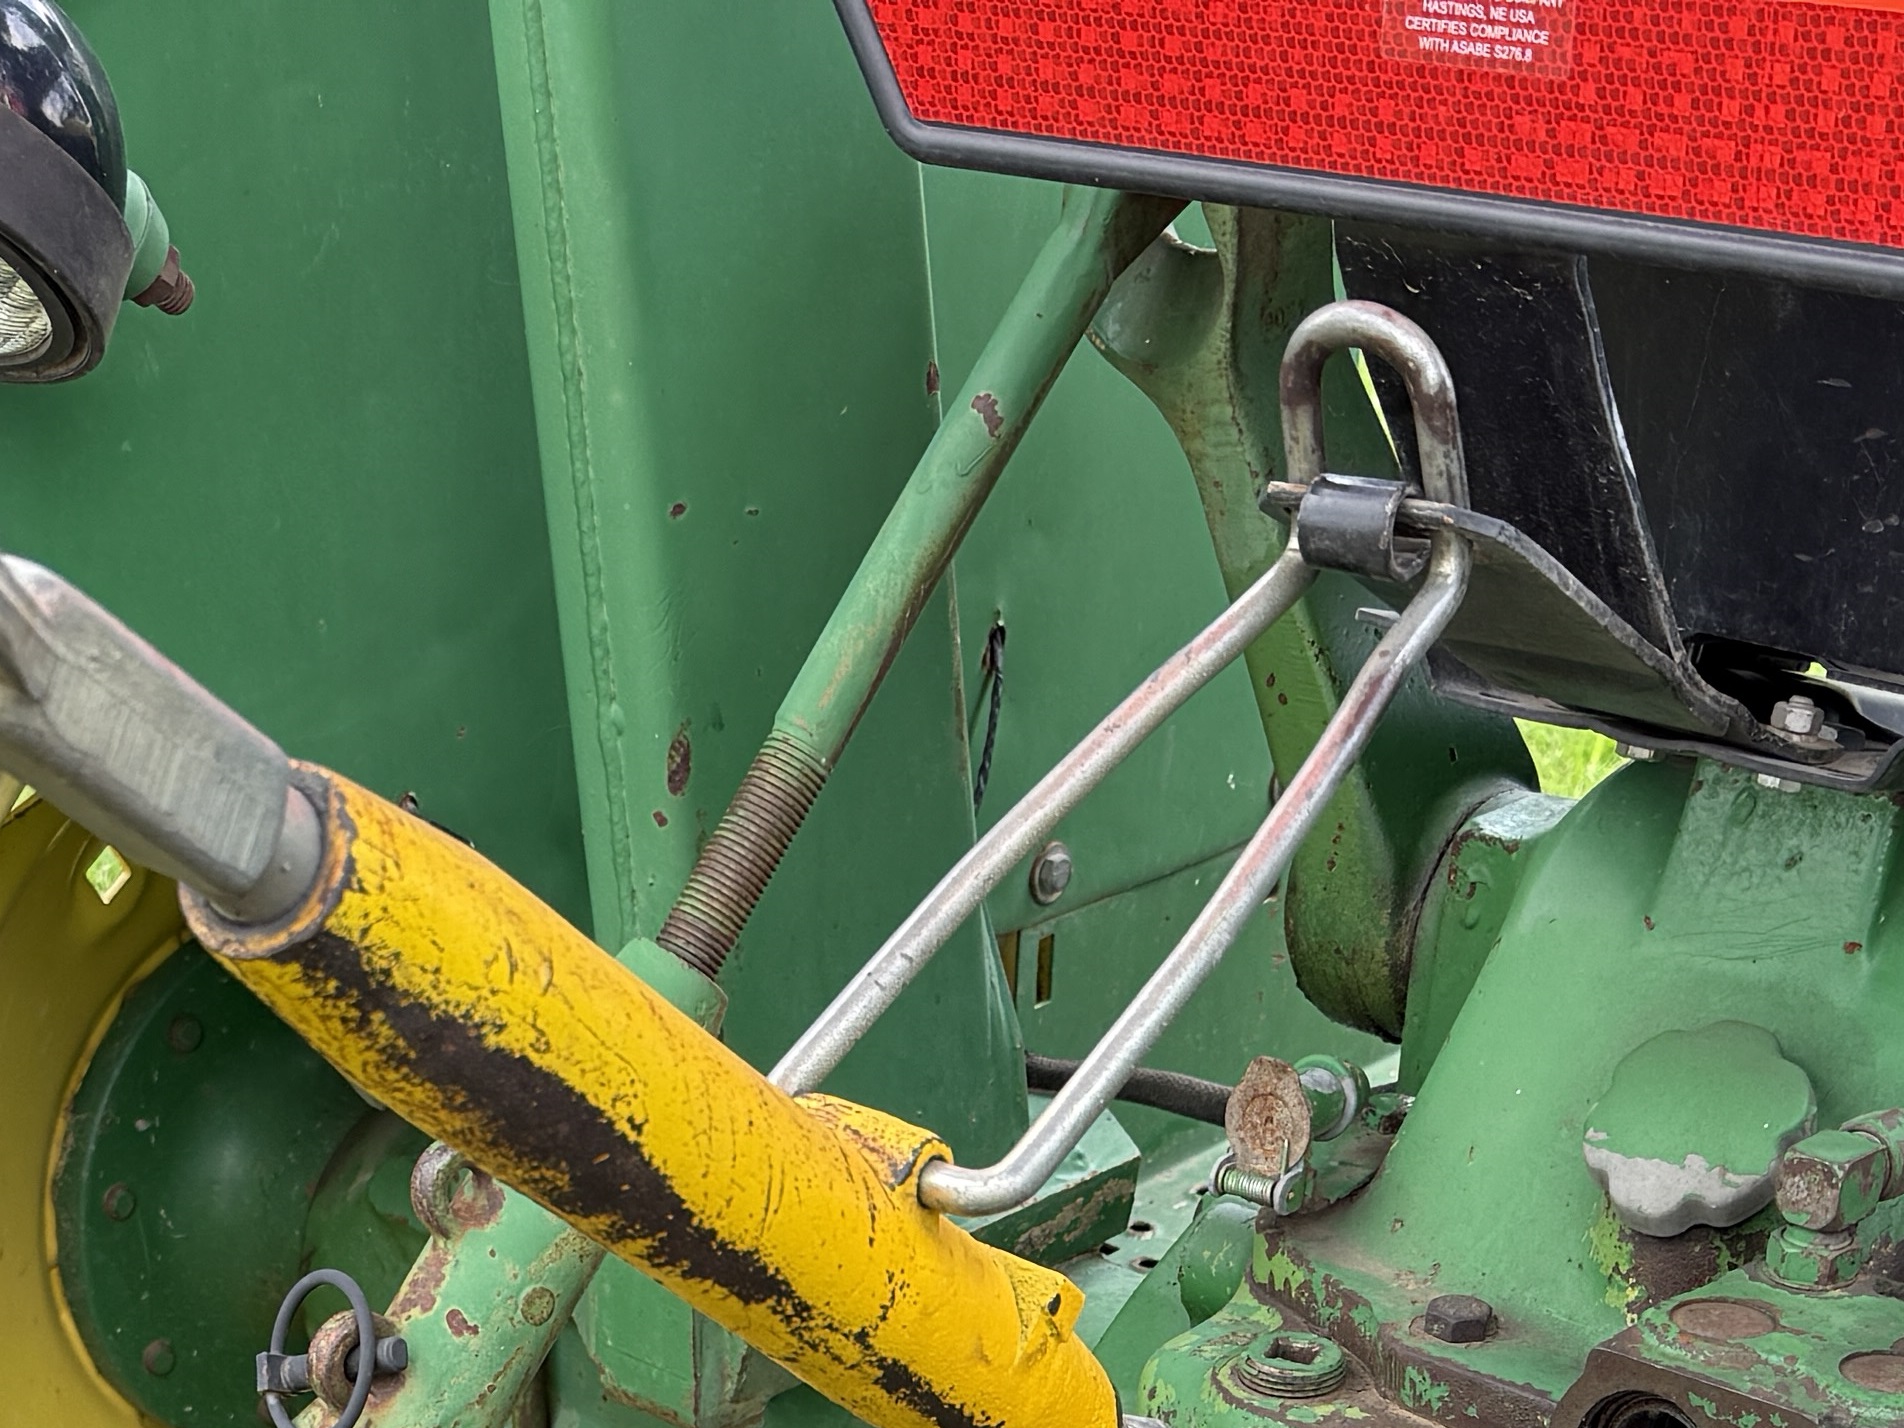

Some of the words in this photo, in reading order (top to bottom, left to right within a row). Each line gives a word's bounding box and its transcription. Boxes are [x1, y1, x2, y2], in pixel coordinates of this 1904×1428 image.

[1422, 0, 1487, 21] HASTINGS,
[1490, 7, 1507, 22] NE
[1509, 9, 1535, 25] USA
[1405, 15, 1467, 36] CERTIFIES
[1469, 22, 1550, 45] COMPLIANCE
[1418, 35, 1450, 51] WITH
[1450, 39, 1491, 58] ASABE
[1493, 44, 1533, 63] S276.8
